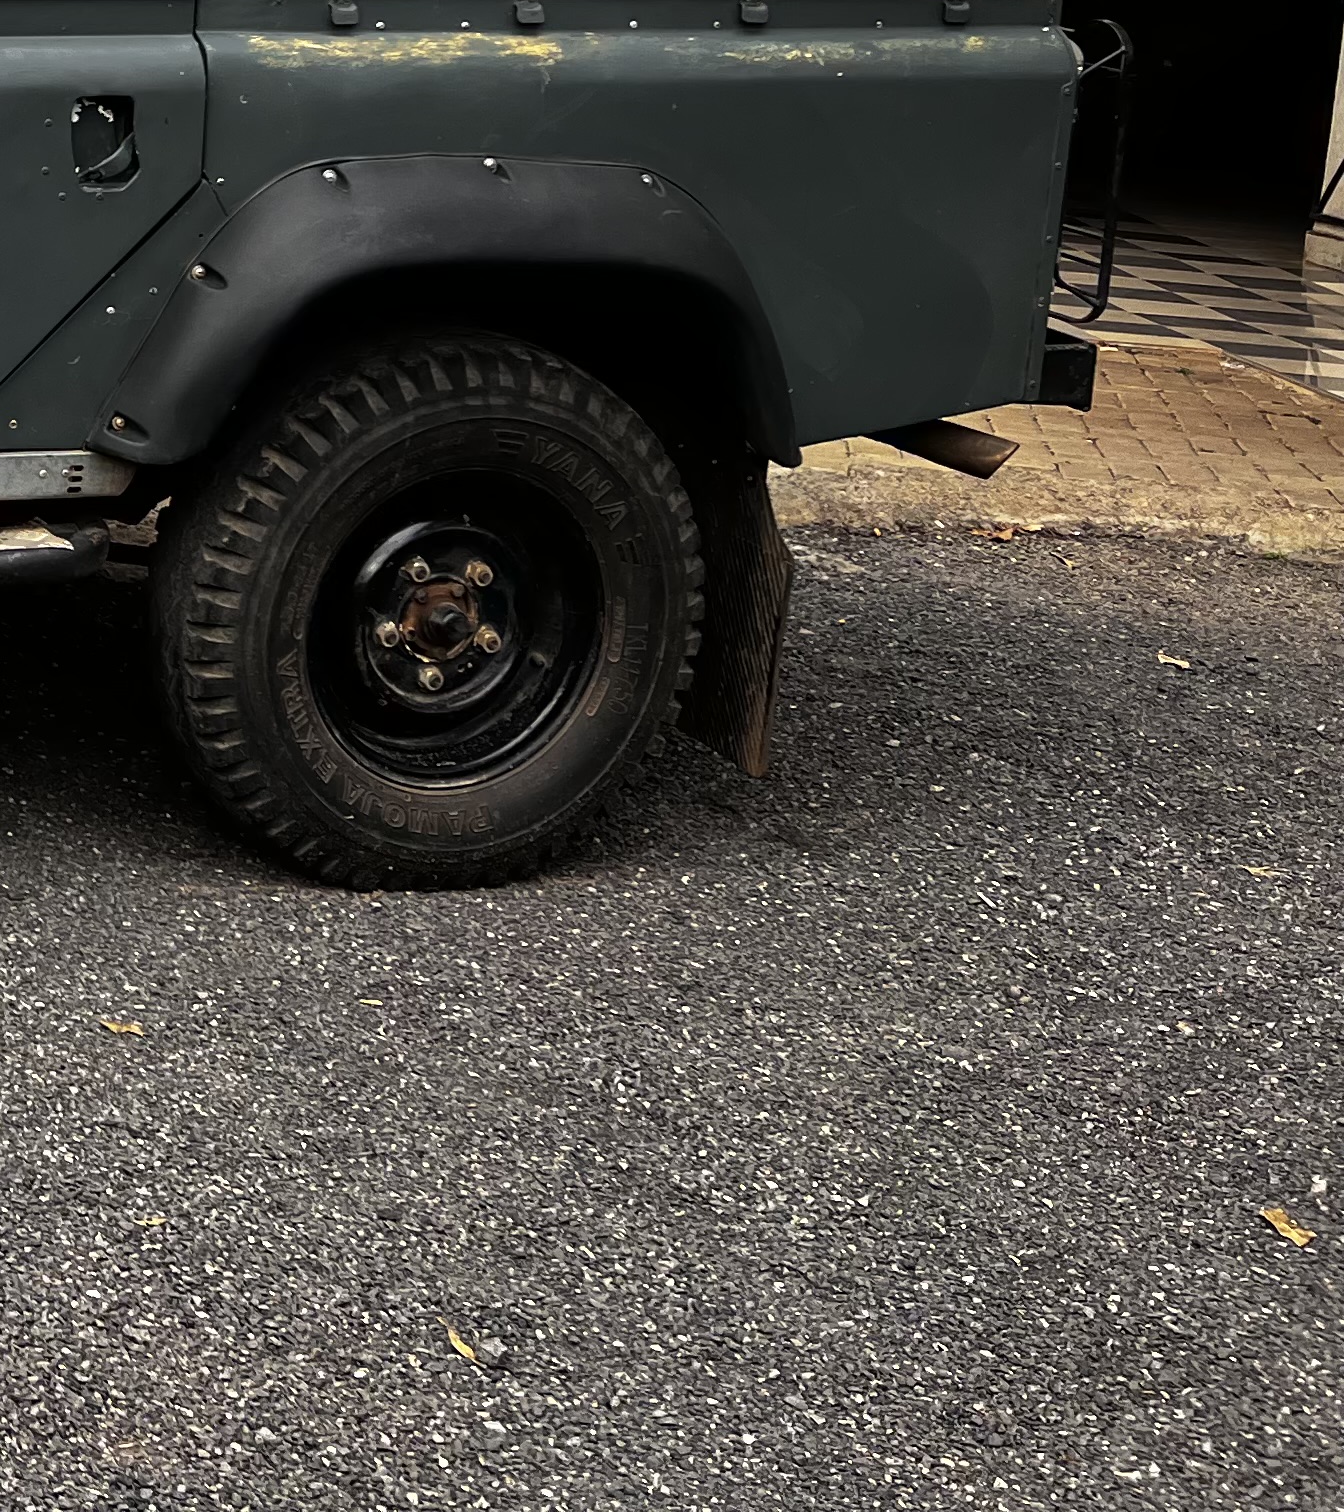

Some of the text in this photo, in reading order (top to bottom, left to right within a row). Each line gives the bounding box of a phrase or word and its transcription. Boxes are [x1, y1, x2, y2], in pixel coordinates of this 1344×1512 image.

[530, 435, 630, 531] YANA
[275, 647, 496, 836] PAMOJA EXTRA
